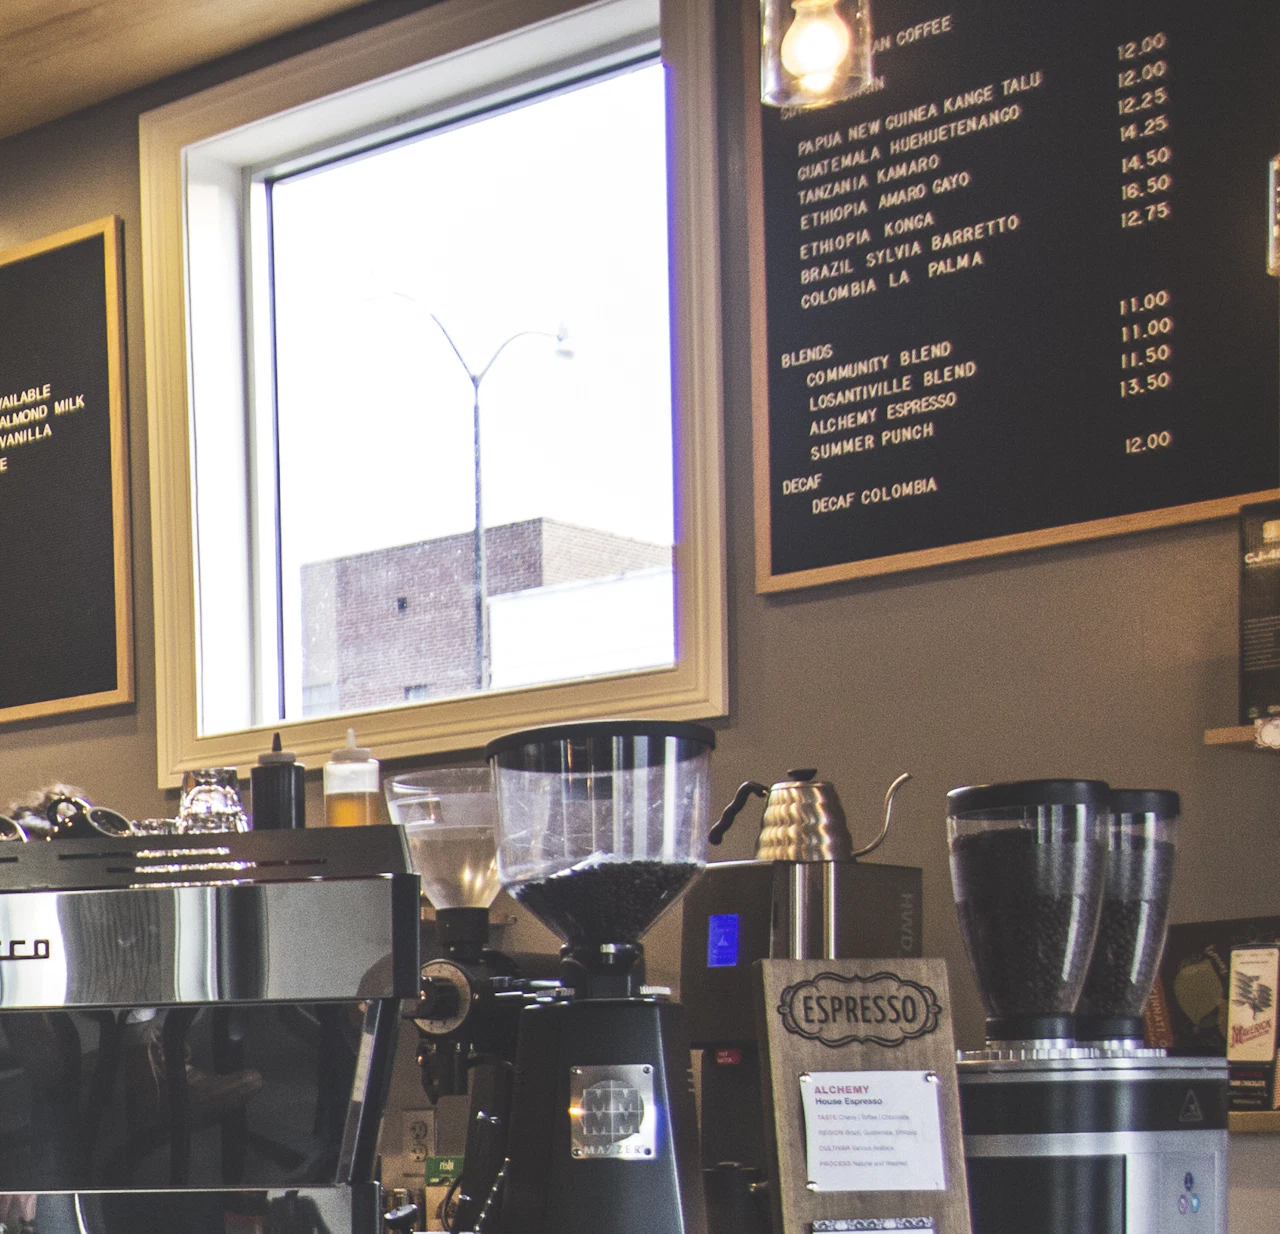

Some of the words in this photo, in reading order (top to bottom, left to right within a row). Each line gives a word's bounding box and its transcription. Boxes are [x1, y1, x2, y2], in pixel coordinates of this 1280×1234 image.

[896, 15, 952, 46] COFFEE
[1117, 32, 1167, 60] 12.00
[1118, 60, 1167, 88] 12.00
[1118, 87, 1168, 115] 12.25
[798, 130, 842, 157] PAPUA
[848, 119, 881, 142] NEW
[885, 103, 938, 130] GUINEA
[943, 84, 993, 114] KANGE
[1120, 114, 1169, 142] 14.25
[797, 146, 881, 180] GUATEMALA
[889, 104, 1022, 155] HUEHUETENANGO
[1121, 146, 1171, 173] 14.50
[798, 174, 869, 205] TANZANIA
[877, 154, 940, 184] KAMARO
[1122, 174, 1171, 200] 16.50
[800, 200, 869, 230] ETHIOPIA
[878, 183, 927, 209] AMARO
[932, 171, 970, 194] GAYO
[1121, 201, 1170, 228] 12.75
[800, 228, 871, 260] ETHIOPIA
[884, 211, 934, 238] KONGA
[801, 258, 854, 285] BRAZIL
[866, 240, 921, 267] SYLVIA
[931, 215, 1020, 251] BARRETTO
[801, 277, 877, 309] COLOMBIA
[889, 269, 910, 288] LA
[928, 251, 983, 278] PALMA
[1120, 290, 1169, 315] 11.00
[1122, 317, 1173, 342] 11.00
[781, 343, 834, 369] BLENDS
[807, 355, 889, 388] COMMUNITY
[900, 340, 952, 366] BLEND
[1121, 343, 1171, 369] 11.50
[809, 375, 912, 411] LOSANTIVILLE
[923, 361, 977, 387] BLEND
[1120, 372, 1170, 398] 13.50
[0, 405, 48, 429] ALMOND
[54, 394, 85, 415] MILK
[809, 407, 877, 436] ALCHEMY
[886, 392, 957, 420] ESPRESSO
[0, 423, 52, 449] VANILLA
[811, 434, 875, 461] SUMMER
[881, 422, 935, 446] PUNCH
[1126, 431, 1172, 453] 12.00
[782, 473, 822, 495] DECAF
[812, 492, 855, 514] DECAF
[861, 477, 937, 504] COLOMBIA
[802, 995, 917, 1024] ESPRESSO
[814, 1085, 870, 1094] ALCHEMY
[844, 1097, 883, 1106] Espresso
[584, 1144, 641, 1154] MAZZER
